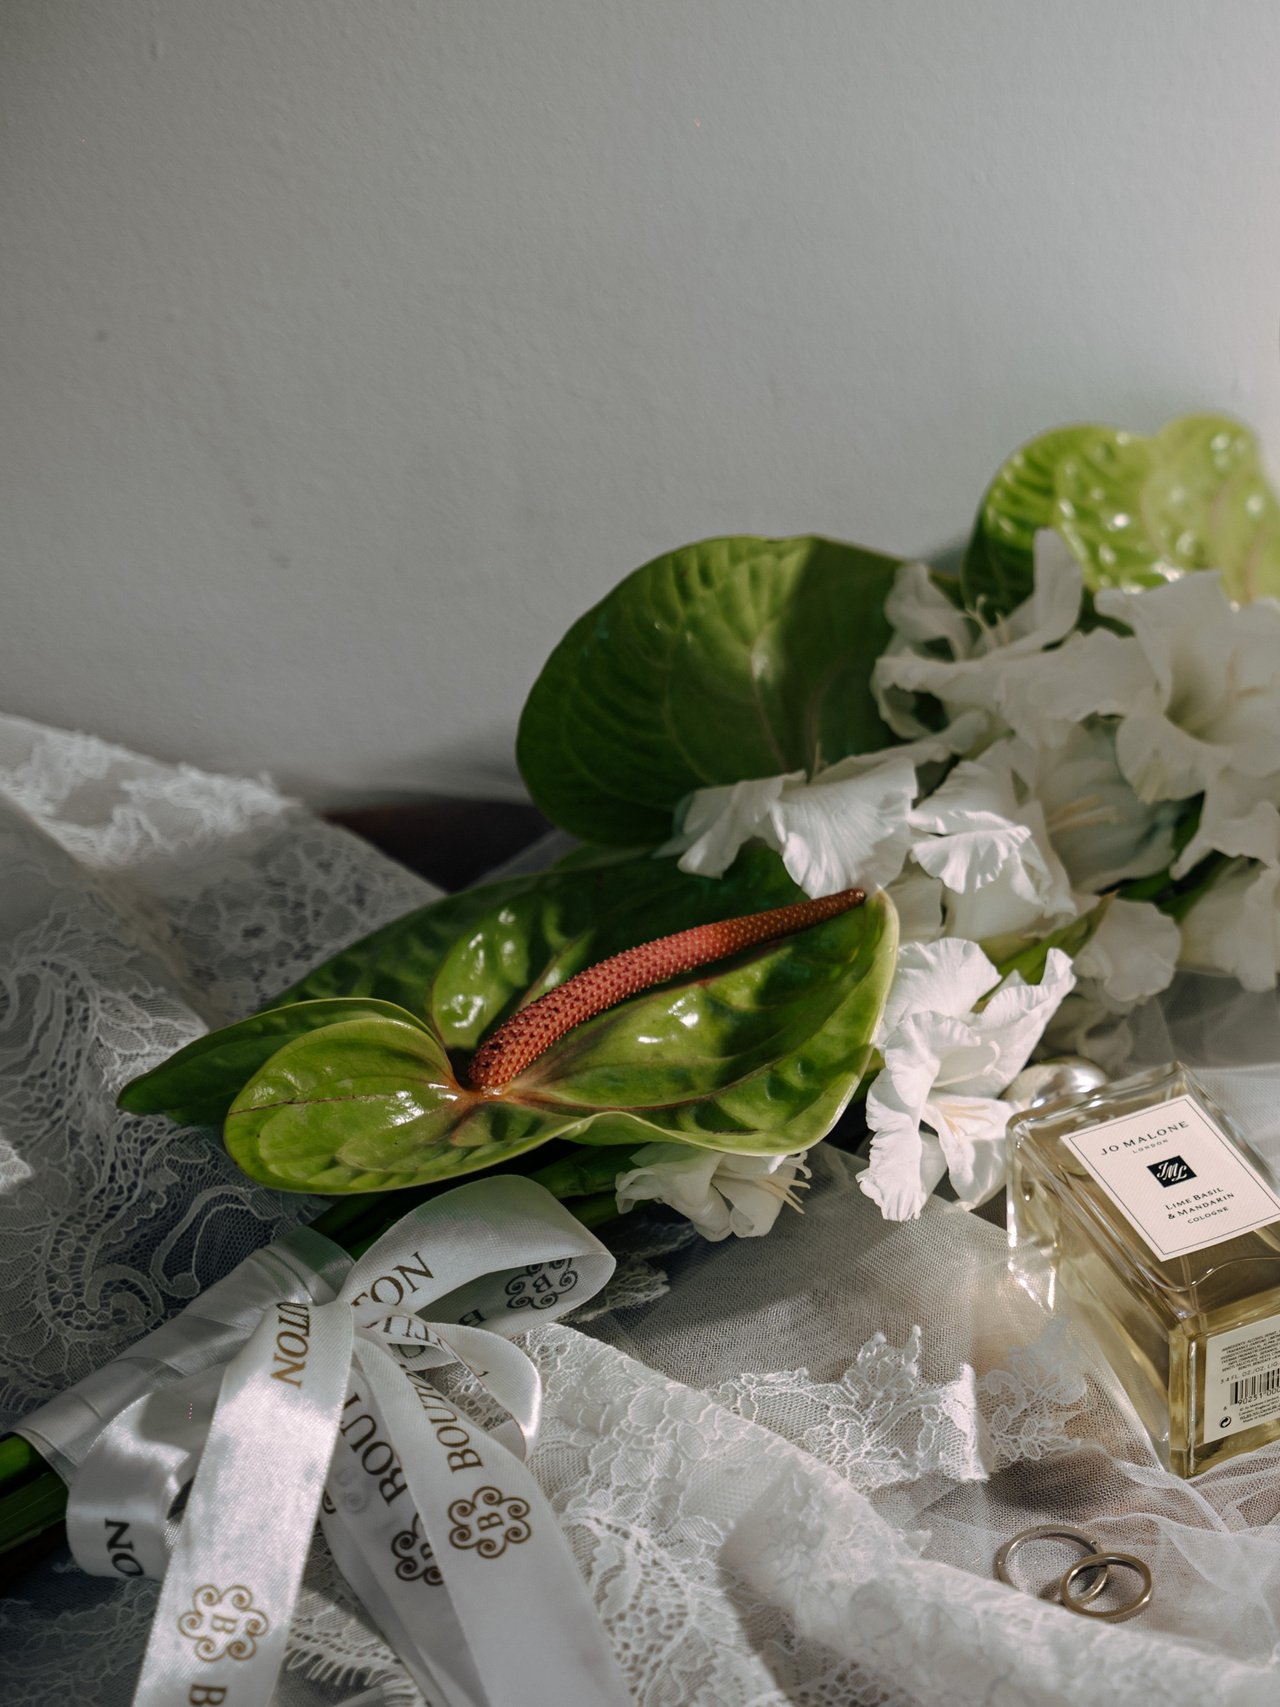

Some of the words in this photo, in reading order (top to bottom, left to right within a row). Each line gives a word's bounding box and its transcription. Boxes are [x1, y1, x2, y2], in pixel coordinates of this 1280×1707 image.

[1100, 1144, 1119, 1156] JO
[1123, 1120, 1189, 1148] MALONE
[1132, 1138, 1169, 1154] LONDON
[1165, 1198, 1192, 1210] LIME
[1193, 1187, 1224, 1201] BASIL
[1167, 1212, 1175, 1220] &
[1177, 1192, 1235, 1217] MANDARIN
[1187, 1206, 1229, 1224] COLOGNE
[399, 1363, 484, 1474] BOUTO
